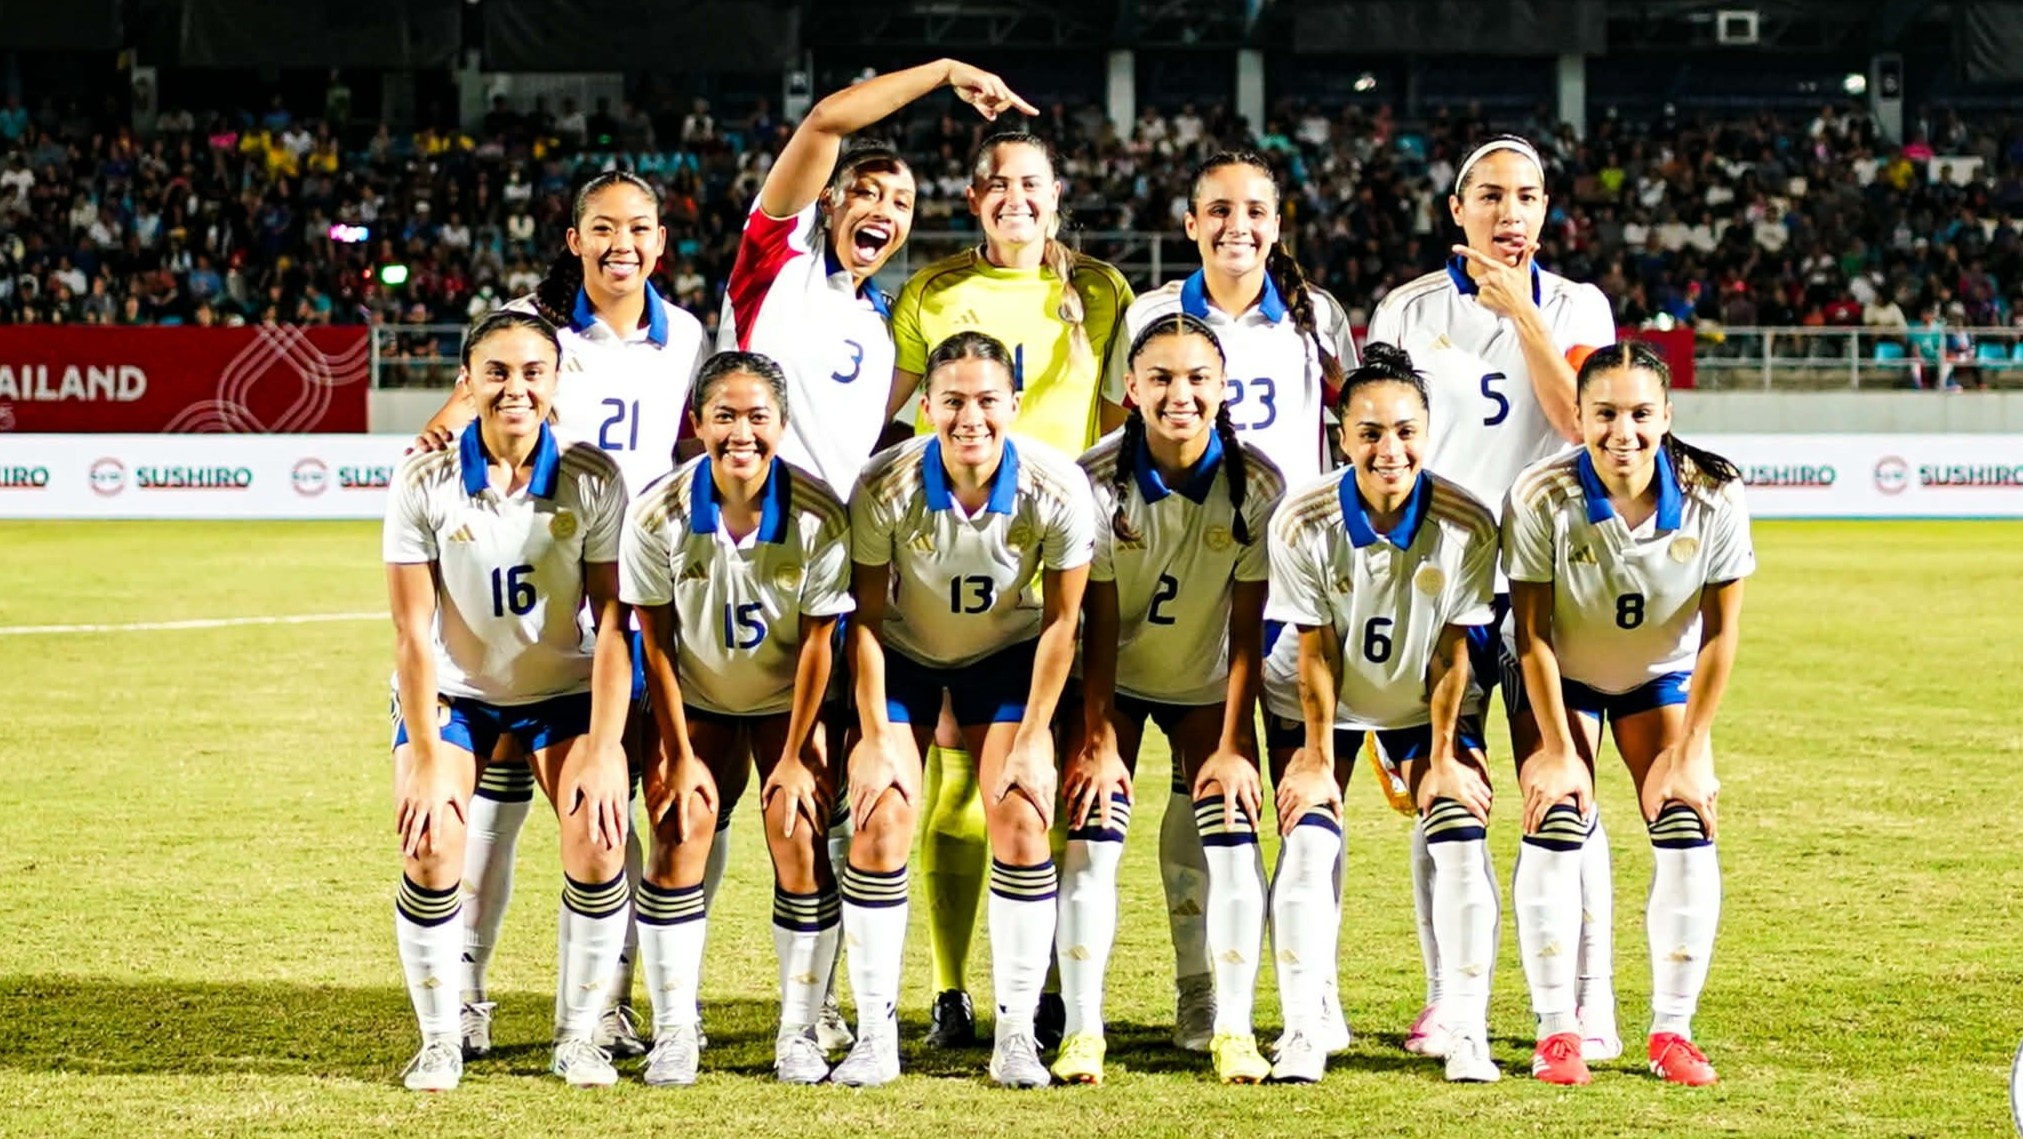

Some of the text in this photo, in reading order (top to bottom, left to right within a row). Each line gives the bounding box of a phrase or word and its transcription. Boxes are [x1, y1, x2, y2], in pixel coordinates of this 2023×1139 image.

[0, 364, 147, 401] AILAND
[831, 339, 864, 384] 3
[1014, 343, 1024, 391] 1
[1226, 377, 1276, 430] 23
[1481, 372, 1509, 426] 5
[599, 397, 639, 451] 21
[136, 466, 252, 488] SUSHIRO
[491, 564, 537, 617] 16
[951, 575, 994, 614] 13
[1148, 573, 1179, 625] 2
[1616, 593, 1645, 629] 8
[724, 602, 766, 649] 15
[1364, 617, 1393, 664] 6
